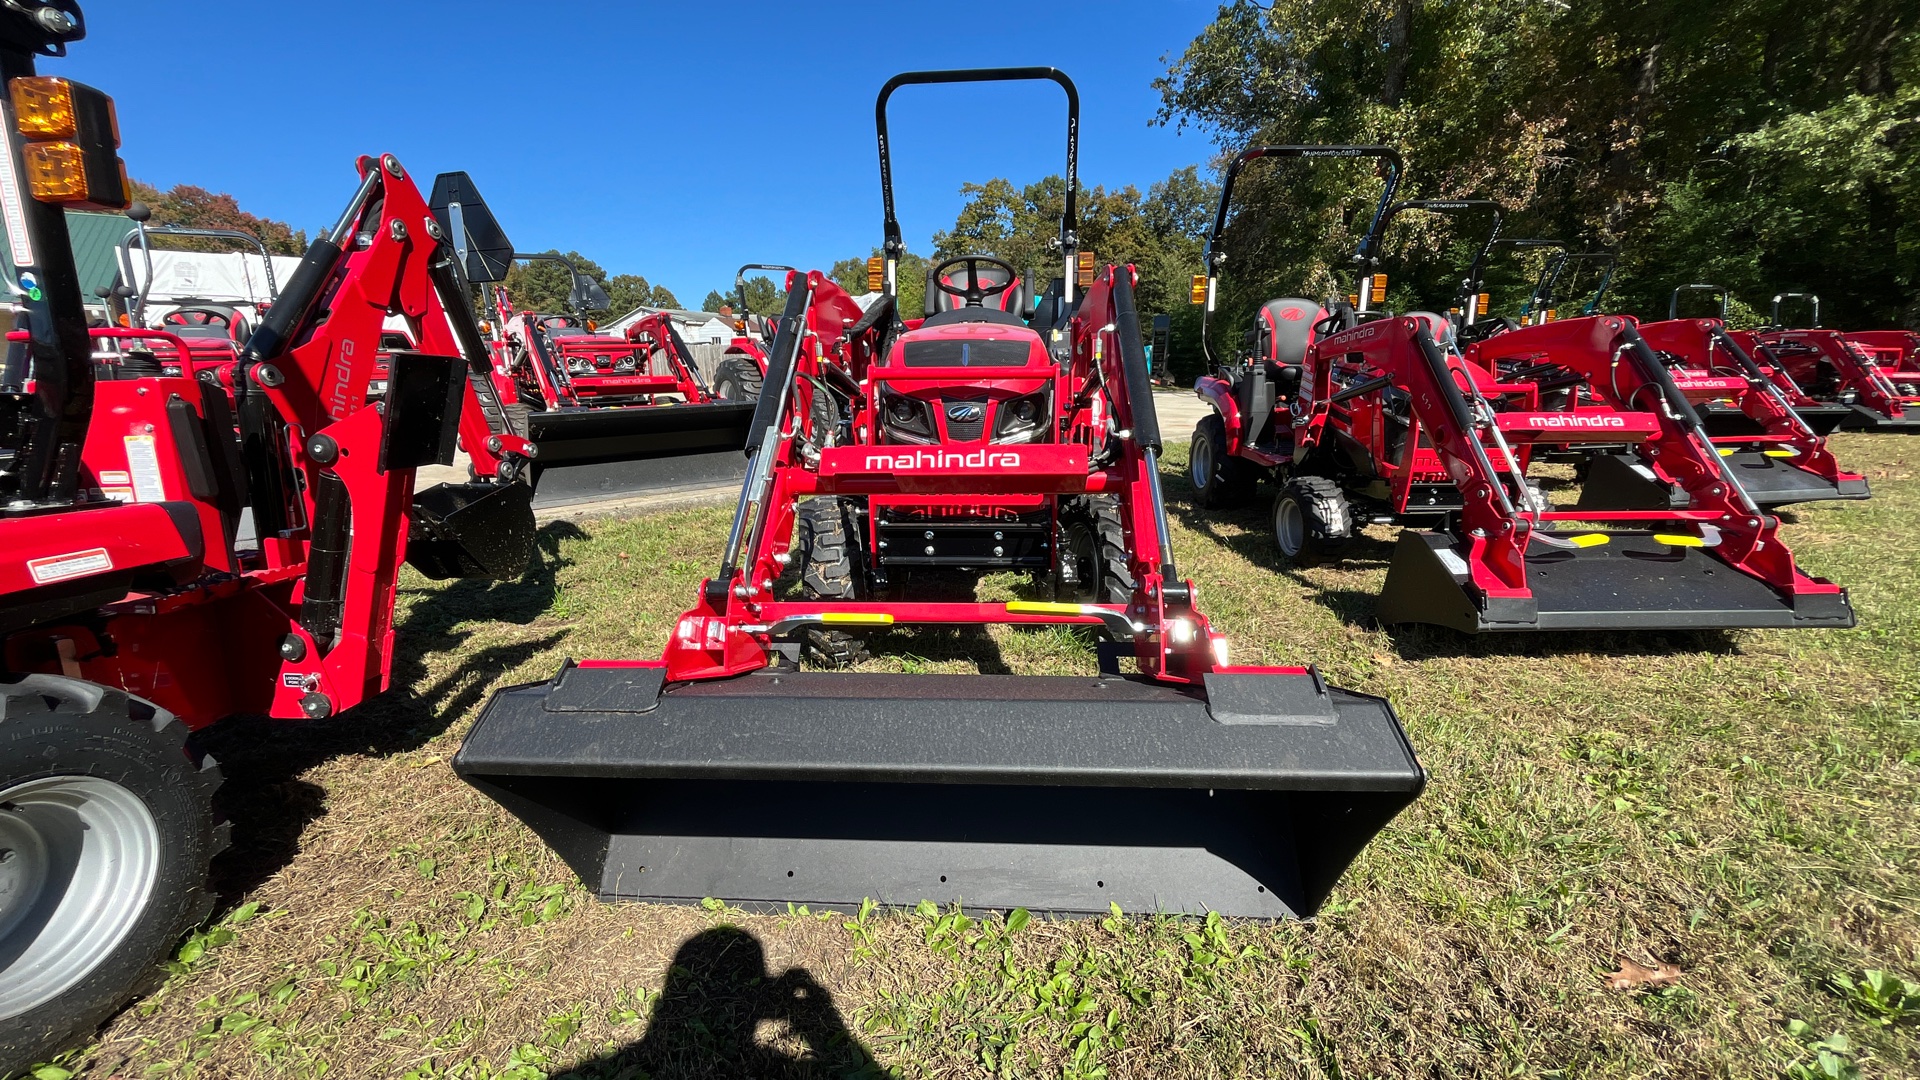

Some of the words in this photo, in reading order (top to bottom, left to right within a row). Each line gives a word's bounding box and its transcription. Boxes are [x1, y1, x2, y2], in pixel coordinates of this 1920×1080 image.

[1333, 327, 1375, 346] mahindra
[327, 338, 355, 421] hindra
[601, 377, 652, 385] mahindra
[1528, 414, 1625, 427] mahindra
[865, 449, 1020, 470] mahindra
